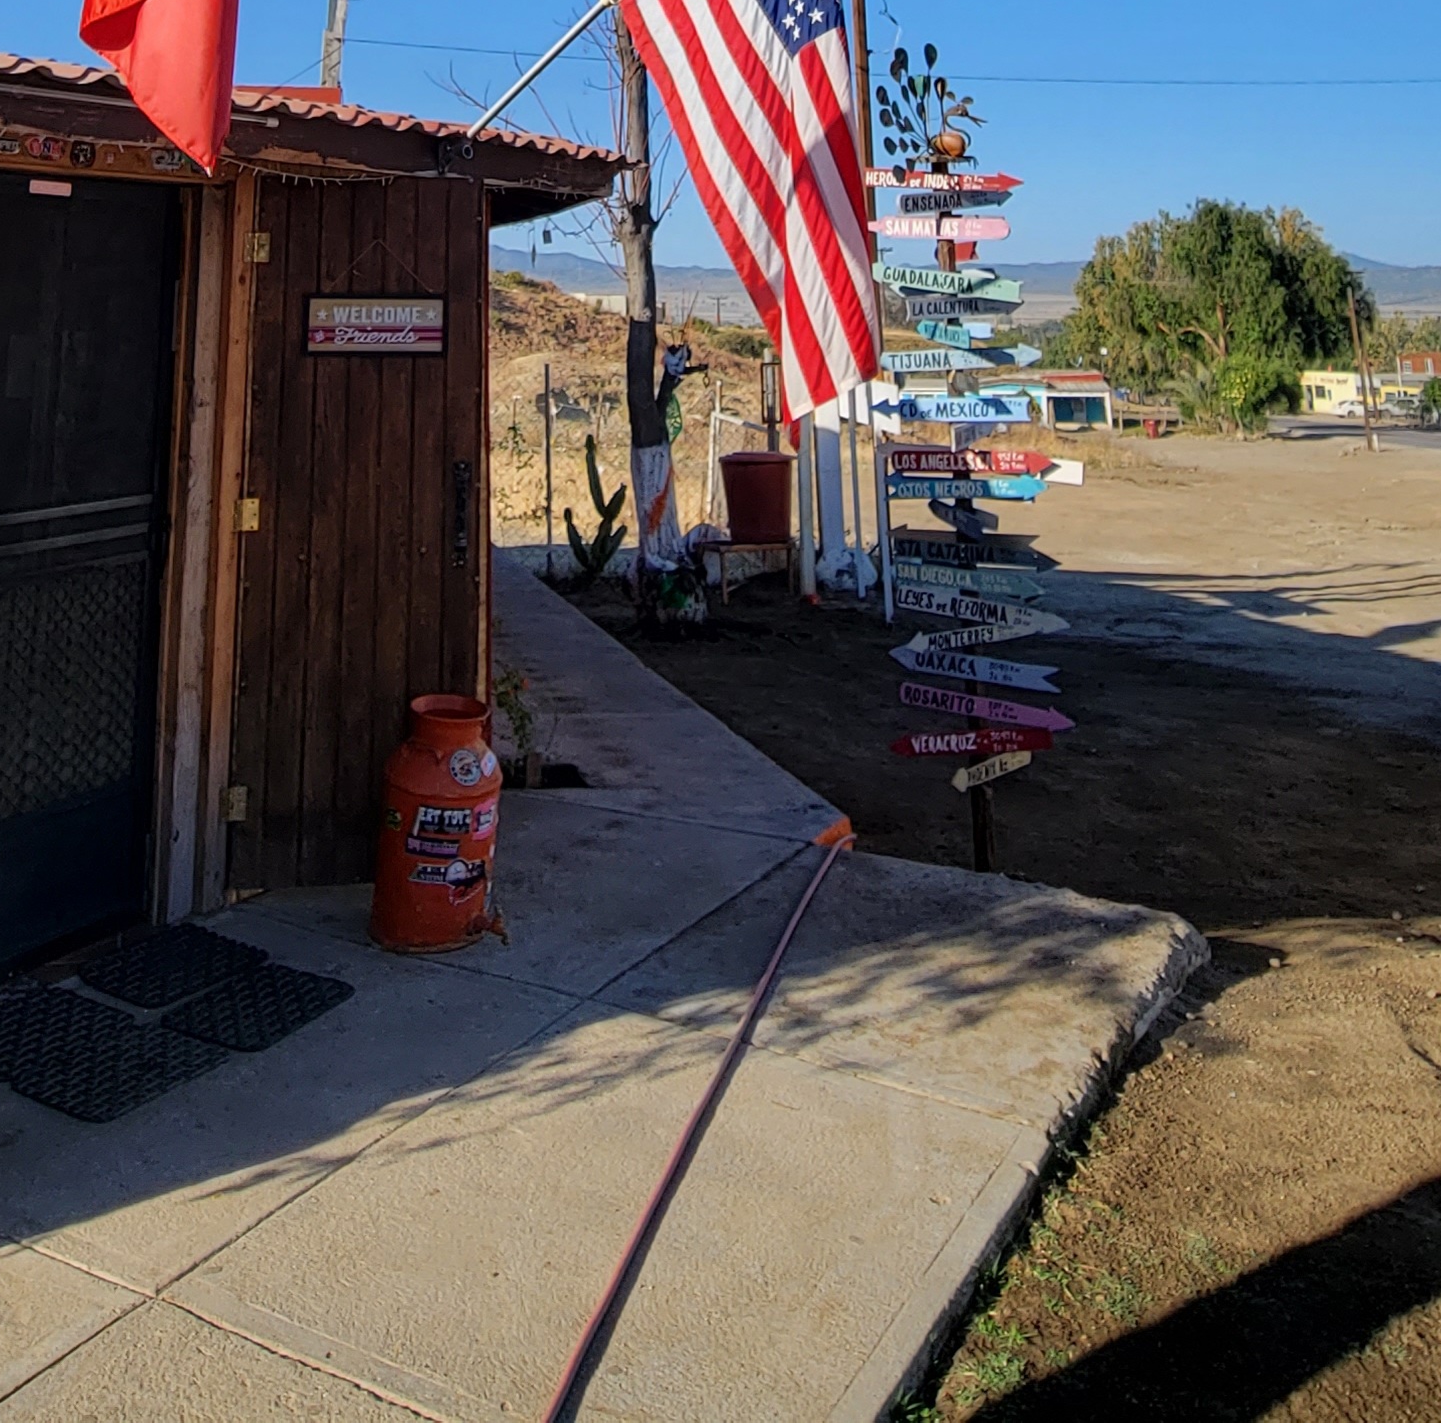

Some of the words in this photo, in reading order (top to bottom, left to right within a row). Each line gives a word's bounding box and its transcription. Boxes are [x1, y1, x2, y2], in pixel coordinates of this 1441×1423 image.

[904, 193, 963, 213] ENSENADA
[885, 219, 909, 237] SAN
[883, 266, 974, 294] GUADALAJARA
[333, 305, 423, 324] WELCOME
[912, 303, 924, 317] LA
[926, 299, 980, 316] CALENTURA
[334, 324, 419, 345] Friends
[888, 353, 952, 370] TIJUANA
[899, 401, 918, 418] CD
[935, 402, 990, 418] MEXICO
[894, 454, 916, 470] LOS
[898, 483, 930, 498] OJOS
[934, 481, 984, 498] NEGROS
[897, 540, 921, 557] STA
[926, 541, 996, 563] CATARINA
[897, 563, 918, 580] SAN
[898, 588, 935, 610] LEYES
[949, 597, 1009, 625] REFORMA
[928, 627, 994, 651] MONTERREY
[904, 685, 976, 714] ROSARITO
[911, 732, 977, 754] VERACRUZ
